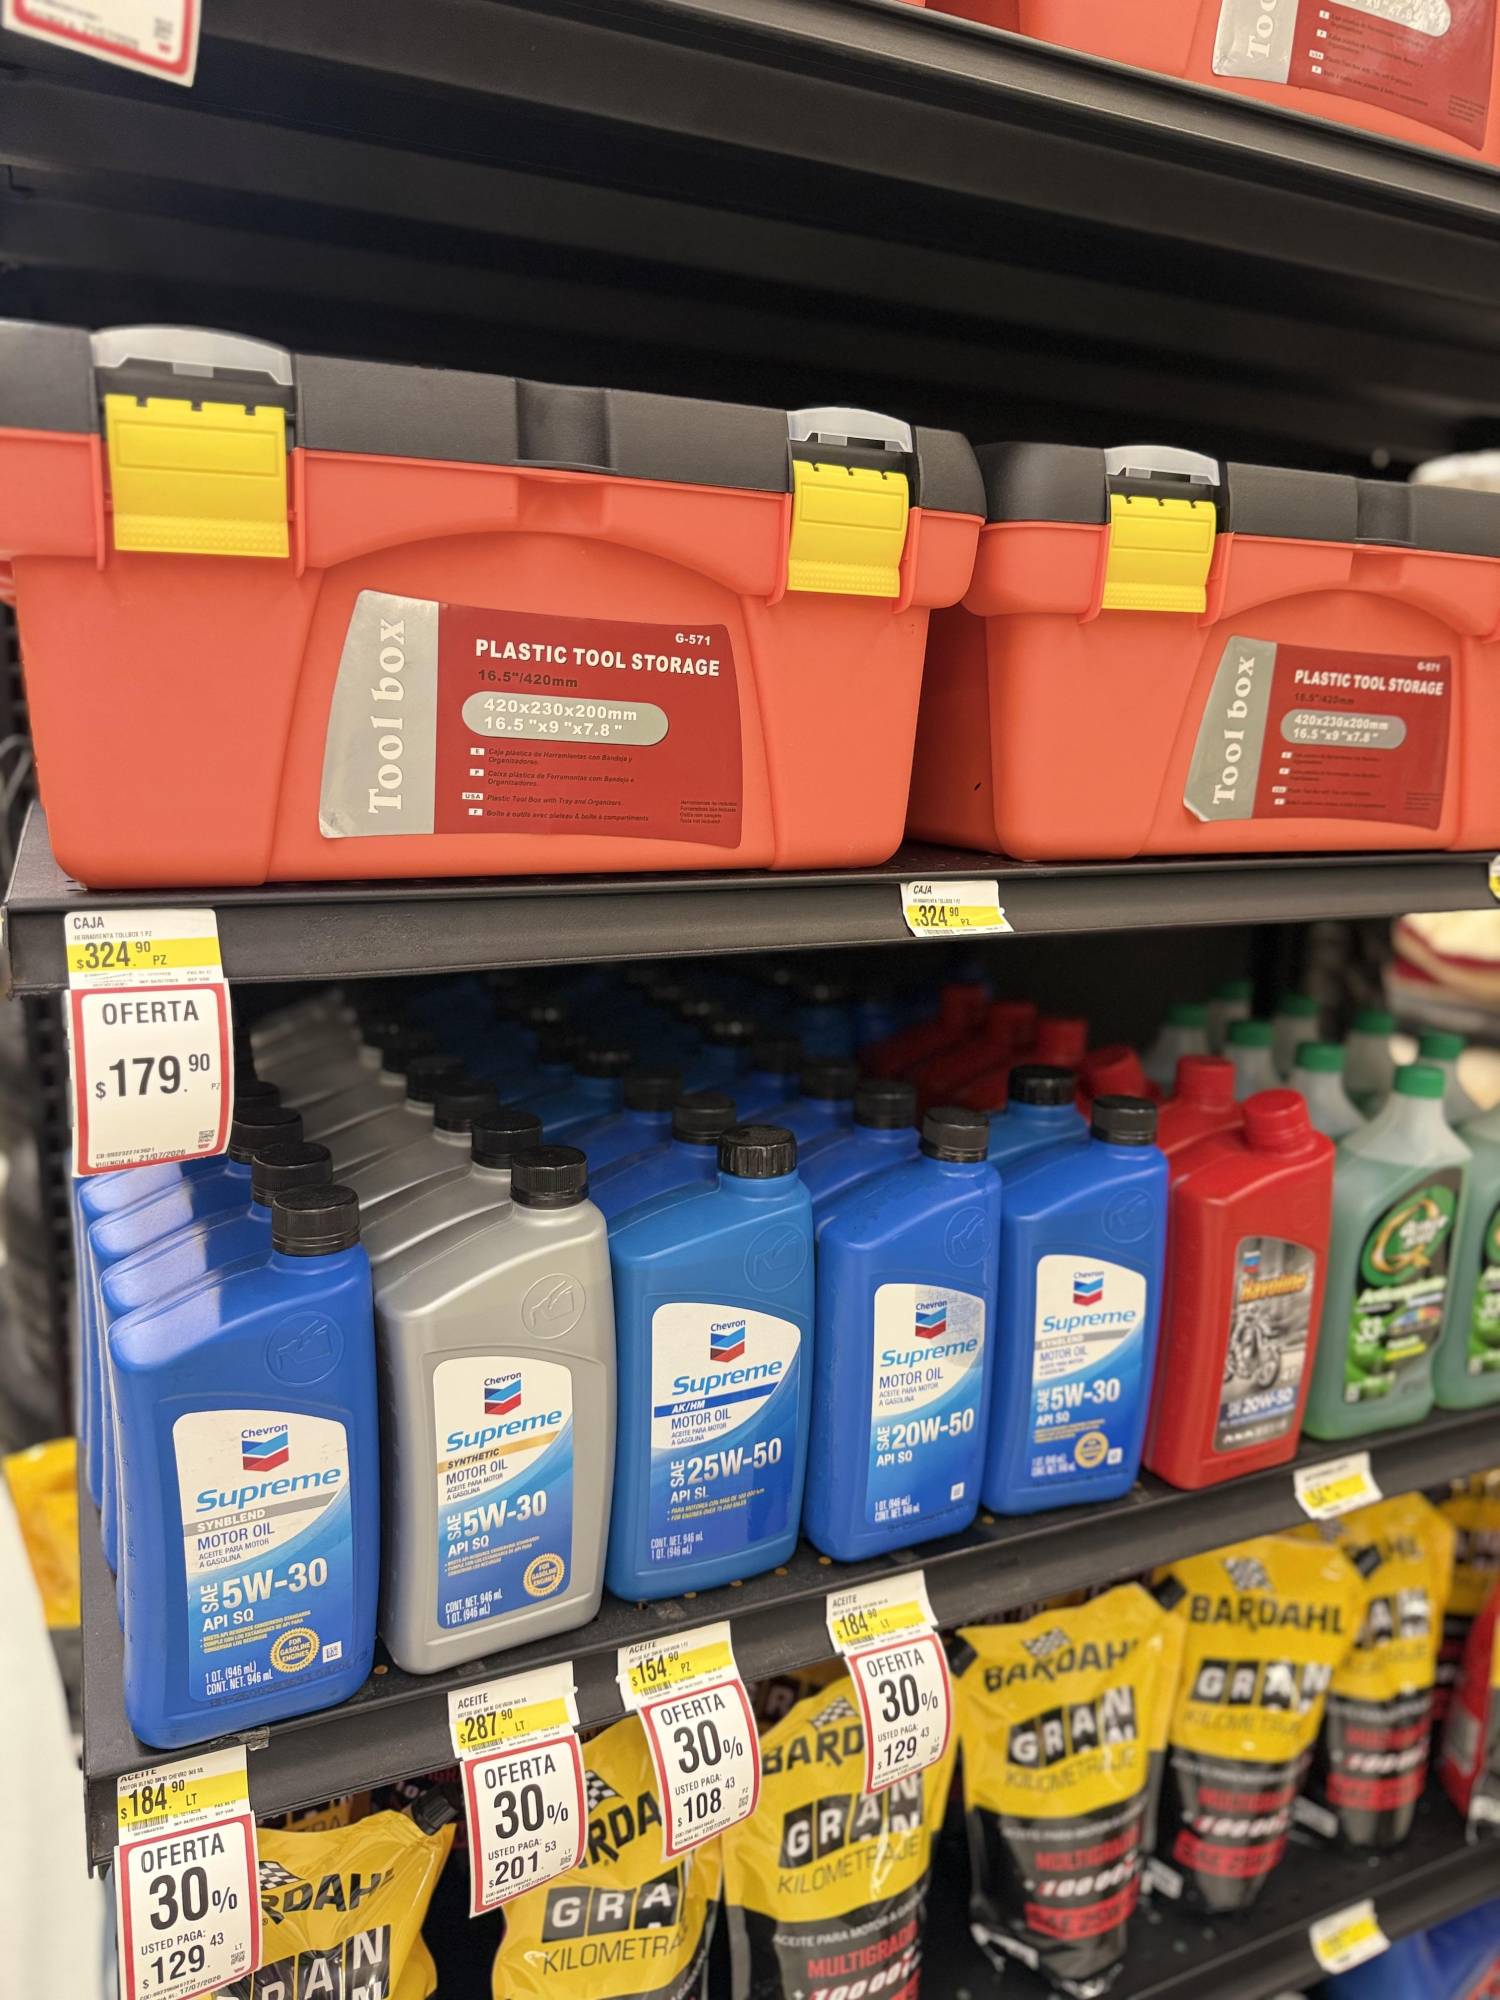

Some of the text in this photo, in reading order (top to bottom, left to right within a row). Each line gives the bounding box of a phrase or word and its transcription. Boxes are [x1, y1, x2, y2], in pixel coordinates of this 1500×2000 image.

[675, 632, 711, 646] G-571
[476, 639, 720, 677] PLASTIC TOOL STORAGE
[478, 669, 578, 688] 16.5"/420mm
[1294, 669, 1444, 696] PLASTIC TOOL STORAGE
[368, 618, 405, 814] Tool box
[484, 698, 637, 721] 420x230x200mm
[484, 716, 524, 731] 16.5
[1213, 655, 1255, 805] Tool box
[1294, 714, 1389, 731] 420x230x200mm
[559, 797, 573, 806] Tray
[913, 885, 932, 895] CAJA
[73, 917, 105, 930] CAJA
[153, 954, 168, 966] PZ
[102, 1000, 200, 1026] OFERTA
[915, 1300, 948, 1311] Chevron
[710, 1319, 746, 1332] Chevron
[1042, 1310, 1136, 1333] Supreme
[880, 1338, 978, 1368] Supreme
[1040, 1347, 1072, 1362] MOTOR
[484, 1372, 522, 1387] Chevron
[672, 1360, 783, 1396] Supreme
[879, 1367, 944, 1389] MOTOR OIL
[1051, 1377, 1120, 1411] 5W-30
[672, 1399, 706, 1414] AK/HM
[446, 1409, 563, 1452] Supreme
[672, 1408, 731, 1430] MOTOR OIL
[876, 1408, 975, 1452] SAE 20W-50
[241, 1424, 288, 1439] Chevron
[447, 1448, 500, 1470] SYNTHETIC
[670, 1437, 782, 1488] SAE 25W-50
[876, 1453, 895, 1467] API
[446, 1458, 508, 1486] MOTOR OIL
[447, 1483, 467, 1494] ACEITE
[483, 1473, 503, 1485] MOTOR
[196, 1468, 341, 1513] Supreme
[452, 1487, 481, 1499] GASOLINA
[670, 1486, 709, 1504] API SL
[197, 1508, 265, 1533] SYNBLEND
[447, 1490, 547, 1541] SAE 5W-30
[197, 1522, 276, 1550] MOTOR OIL
[448, 1535, 490, 1558] API SQ
[198, 1537, 270, 1561] ACEITE PARA MOTOR
[206, 1553, 241, 1567] GASOLINA
[201, 1557, 328, 1614] SAE 5W-30
[445, 1599, 465, 1614] CONT.
[465, 1594, 479, 1608] NET.
[480, 1590, 493, 1602] 946
[832, 1594, 856, 1608] ACEITE
[203, 1608, 255, 1632] API SQ
[446, 1614, 450, 1625] 1
[452, 1611, 462, 1624] QT.
[463, 1607, 478, 1622] (946
[1189, 1595, 1344, 1634] BARDAHL
[280, 1641, 311, 1656] GASOLINE
[289, 1637, 302, 1646] FOR
[629, 1641, 657, 1654] ACEITE
[205, 1660, 257, 1683] 1 QT. (946 mL)
[681, 1661, 691, 1673] PZ
[866, 1648, 924, 1678] OFERTA
[984, 1638, 1139, 1693] BARDAH
[206, 1668, 273, 1695] CONT. NET. 946 mL
[1197, 1660, 1332, 1702] GRAN
[458, 1692, 489, 1709] ACEITE
[660, 1693, 725, 1726] OFERTA
[878, 1674, 938, 1723] 30%
[515, 1720, 526, 1732] LT
[878, 1729, 899, 1743] USTED
[1009, 1685, 1134, 1764] GRAN
[673, 1719, 743, 1774] 30%
[762, 1724, 865, 1777] BARD
[120, 1769, 157, 1783] ACEITE
[484, 1753, 557, 1790] OFERTA
[675, 1773, 722, 1796] USTED PAGA:
[185, 1793, 197, 1806] LT
[493, 1783, 569, 1840] 30%
[140, 1832, 225, 1874] OFERTA
[488, 1838, 543, 1861] USTED PAGA:
[149, 1866, 238, 1931] 30%
[552, 1883, 673, 1929] GRA
[141, 1930, 206, 1956] USTED PAGA:
[234, 1943, 243, 1951] LT
[772, 1930, 849, 1947] ACEITE PARA
